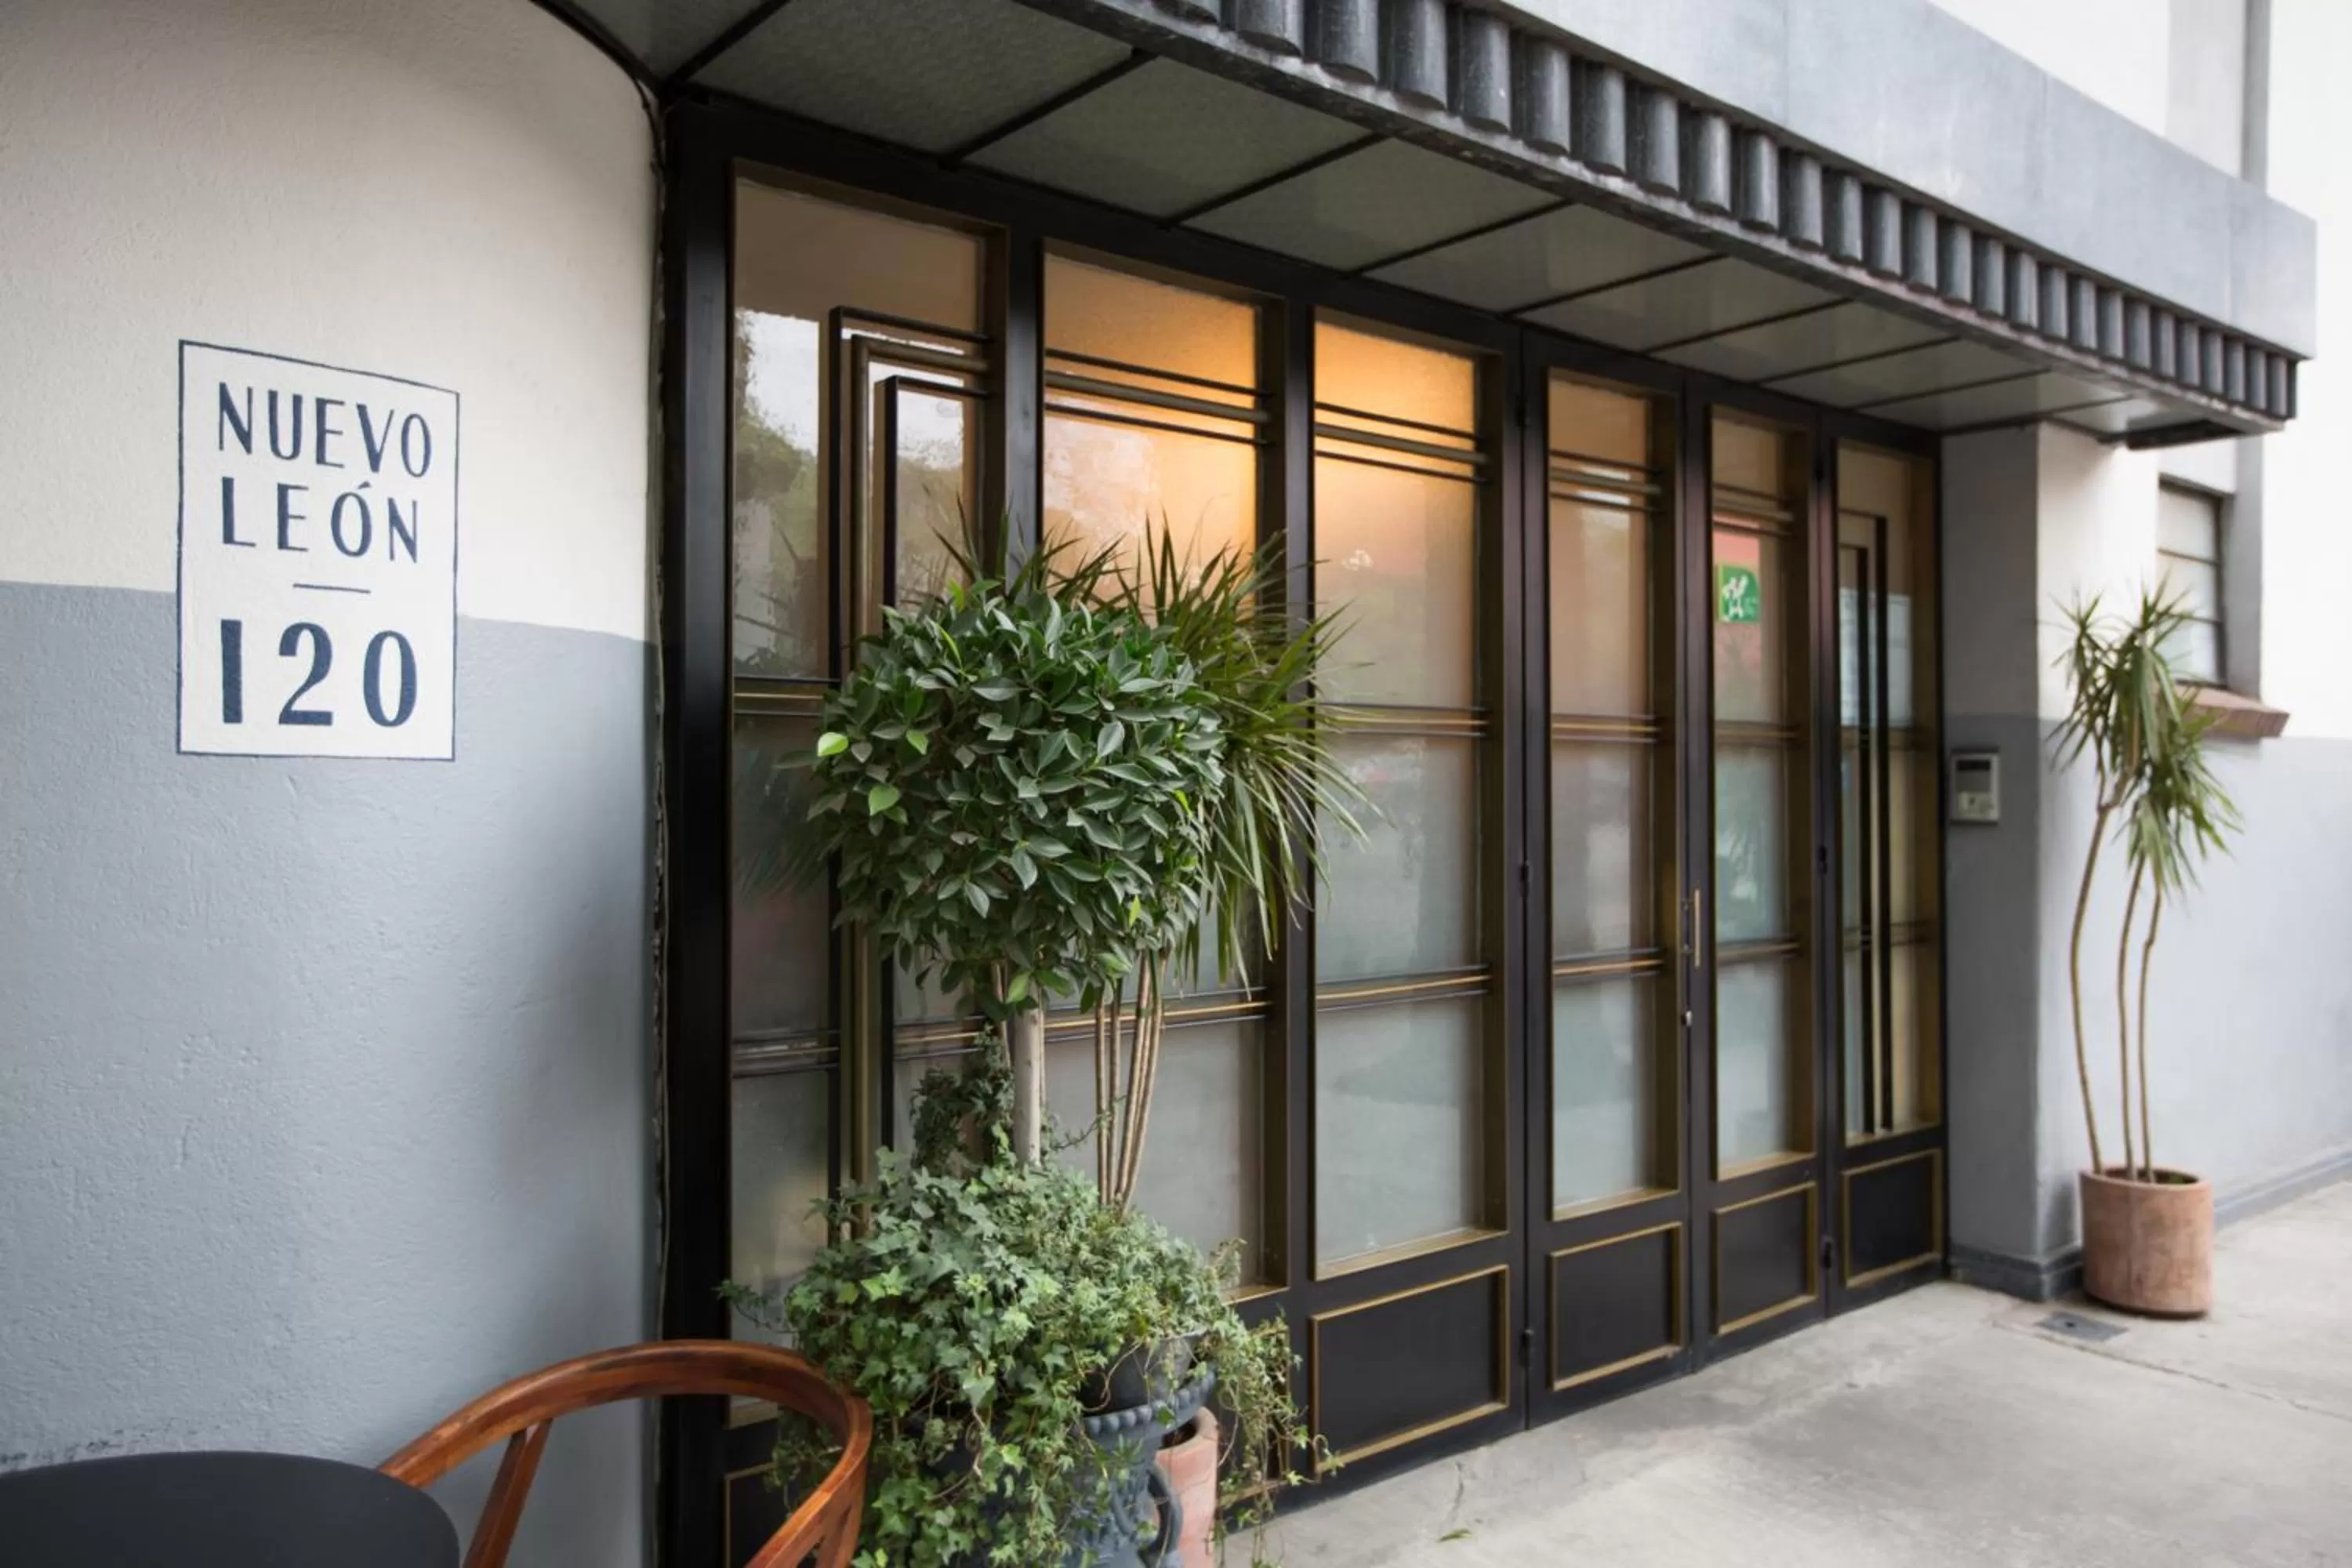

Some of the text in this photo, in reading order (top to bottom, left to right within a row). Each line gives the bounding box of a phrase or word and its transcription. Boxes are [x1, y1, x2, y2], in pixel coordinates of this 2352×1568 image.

[218, 382, 432, 478] NUEVO
[221, 476, 419, 564] LEÓN
[220, 619, 418, 728] 120
